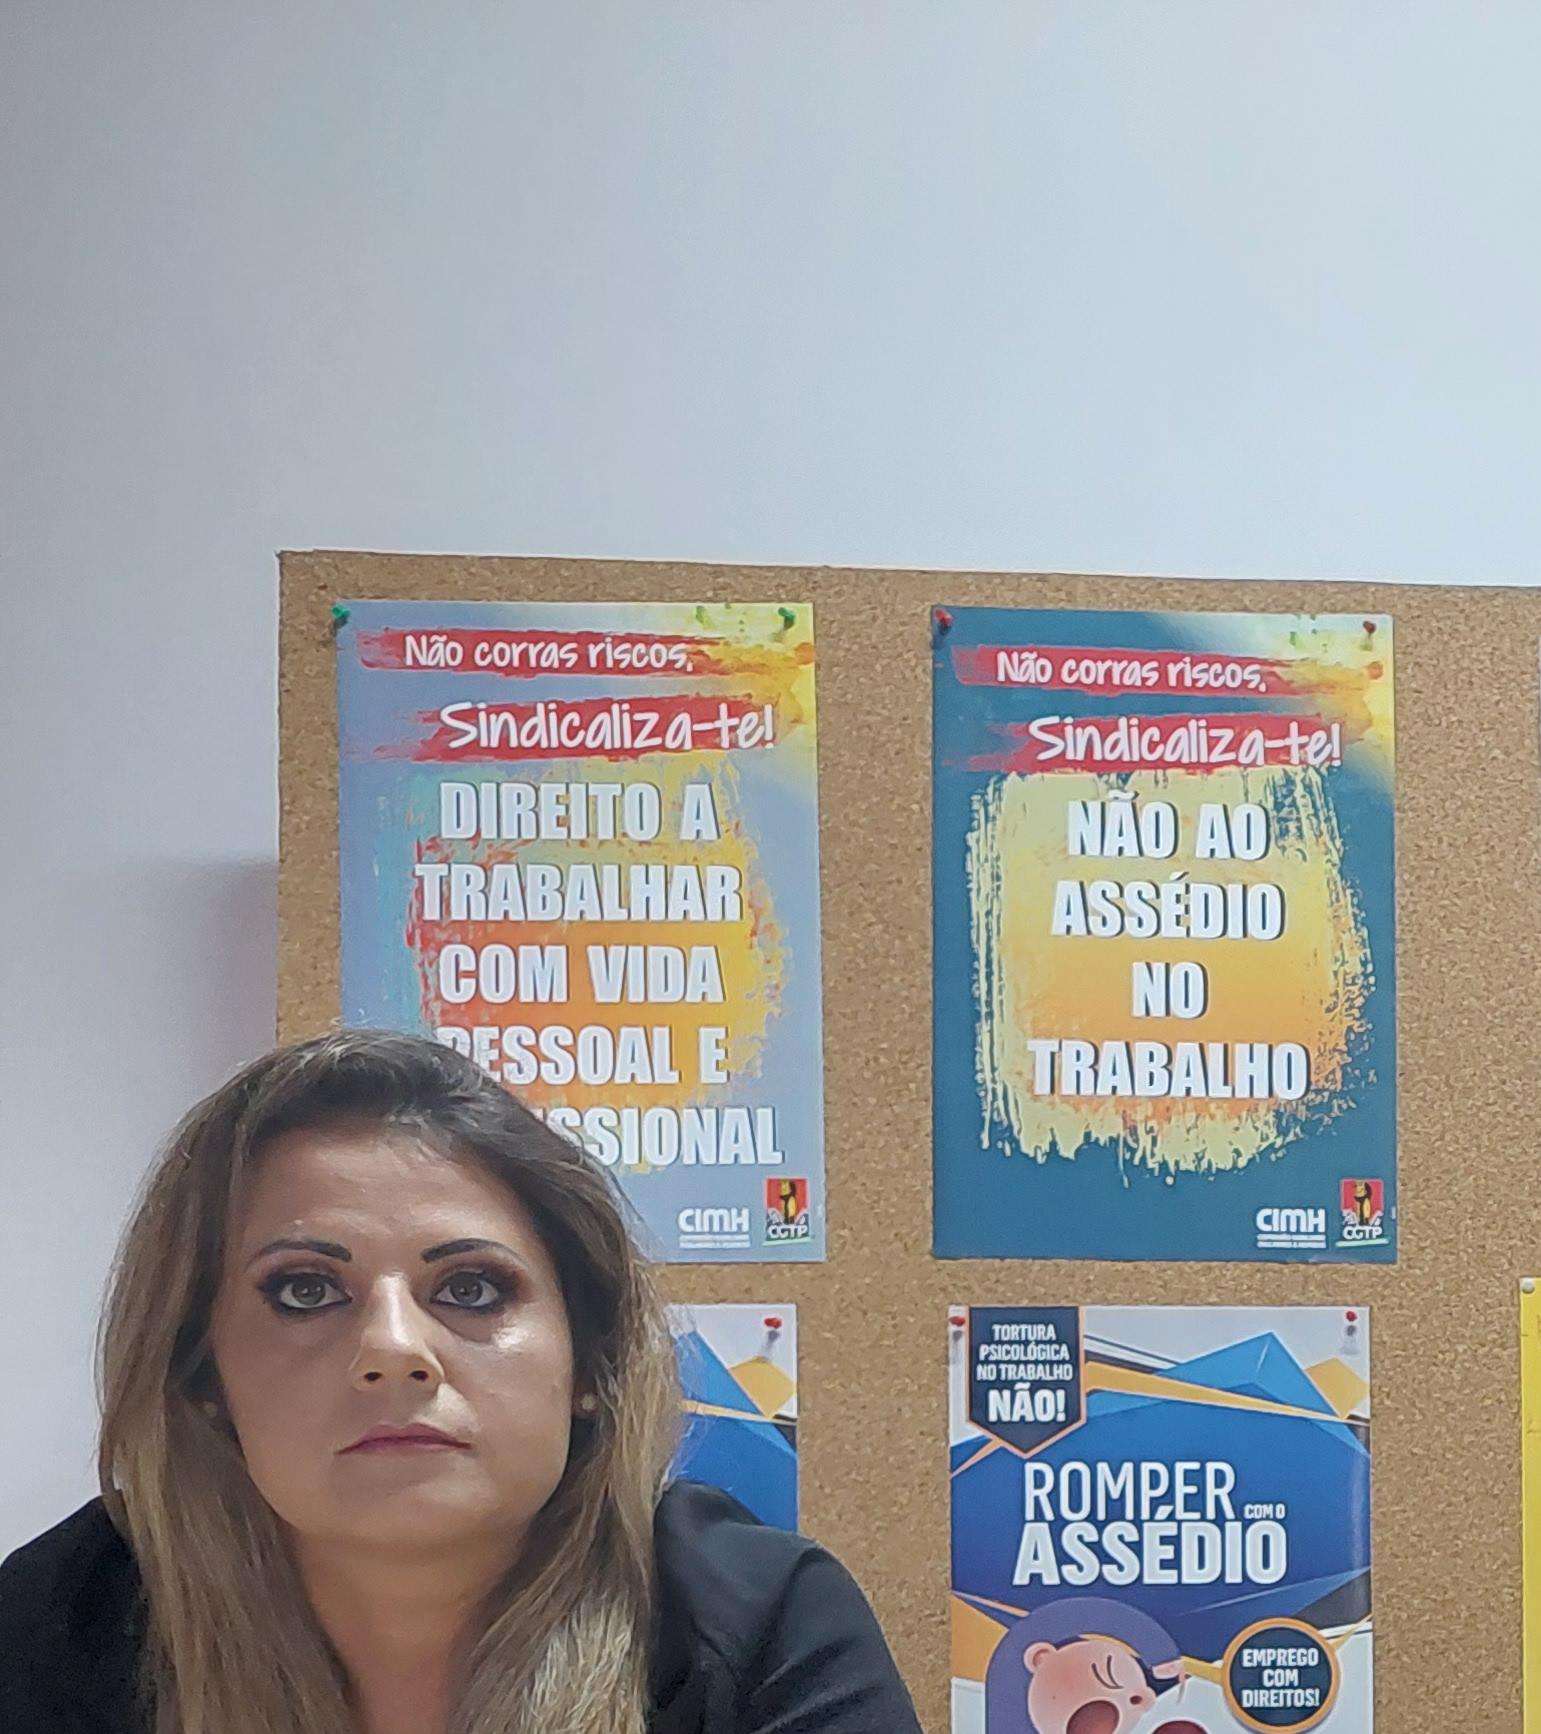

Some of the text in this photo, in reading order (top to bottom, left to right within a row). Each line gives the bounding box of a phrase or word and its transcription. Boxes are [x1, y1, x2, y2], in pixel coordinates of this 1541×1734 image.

[406, 636, 464, 668] Não
[474, 640, 579, 669] corras
[997, 651, 1052, 683] Não
[1060, 658, 1159, 686] corras
[440, 702, 775, 750] Sindicaliza-te!
[1029, 716, 1341, 766] Sindicaliza-te!
[439, 782, 718, 841] DIREITO A
[1067, 790, 1270, 860] NÃO AO
[415, 864, 742, 921] TRABALHAR
[1051, 871, 1285, 940] ASSÉDIO
[439, 945, 725, 1004] COM VIDA
[1131, 962, 1205, 1019] NO
[699, 1027, 729, 1085] E
[1027, 1039, 1309, 1099] TRABALHO
[679, 1207, 750, 1233] CIMH
[1256, 1209, 1325, 1233] CIMH
[980, 1342, 1069, 1362] PSICOLÓGICA
[993, 1325, 1056, 1342] TORTURA
[977, 1363, 1073, 1381] NO TRABALHO
[988, 1383, 1066, 1422] NÃO!
[1025, 1462, 1285, 1521] ROMPER COM O
[1012, 1506, 1287, 1585] ASSÉDIO
[1243, 1648, 1319, 1667] EMPREGO
[1262, 1669, 1298, 1687] COM
[1242, 1689, 1320, 1708] DIREITOS!
